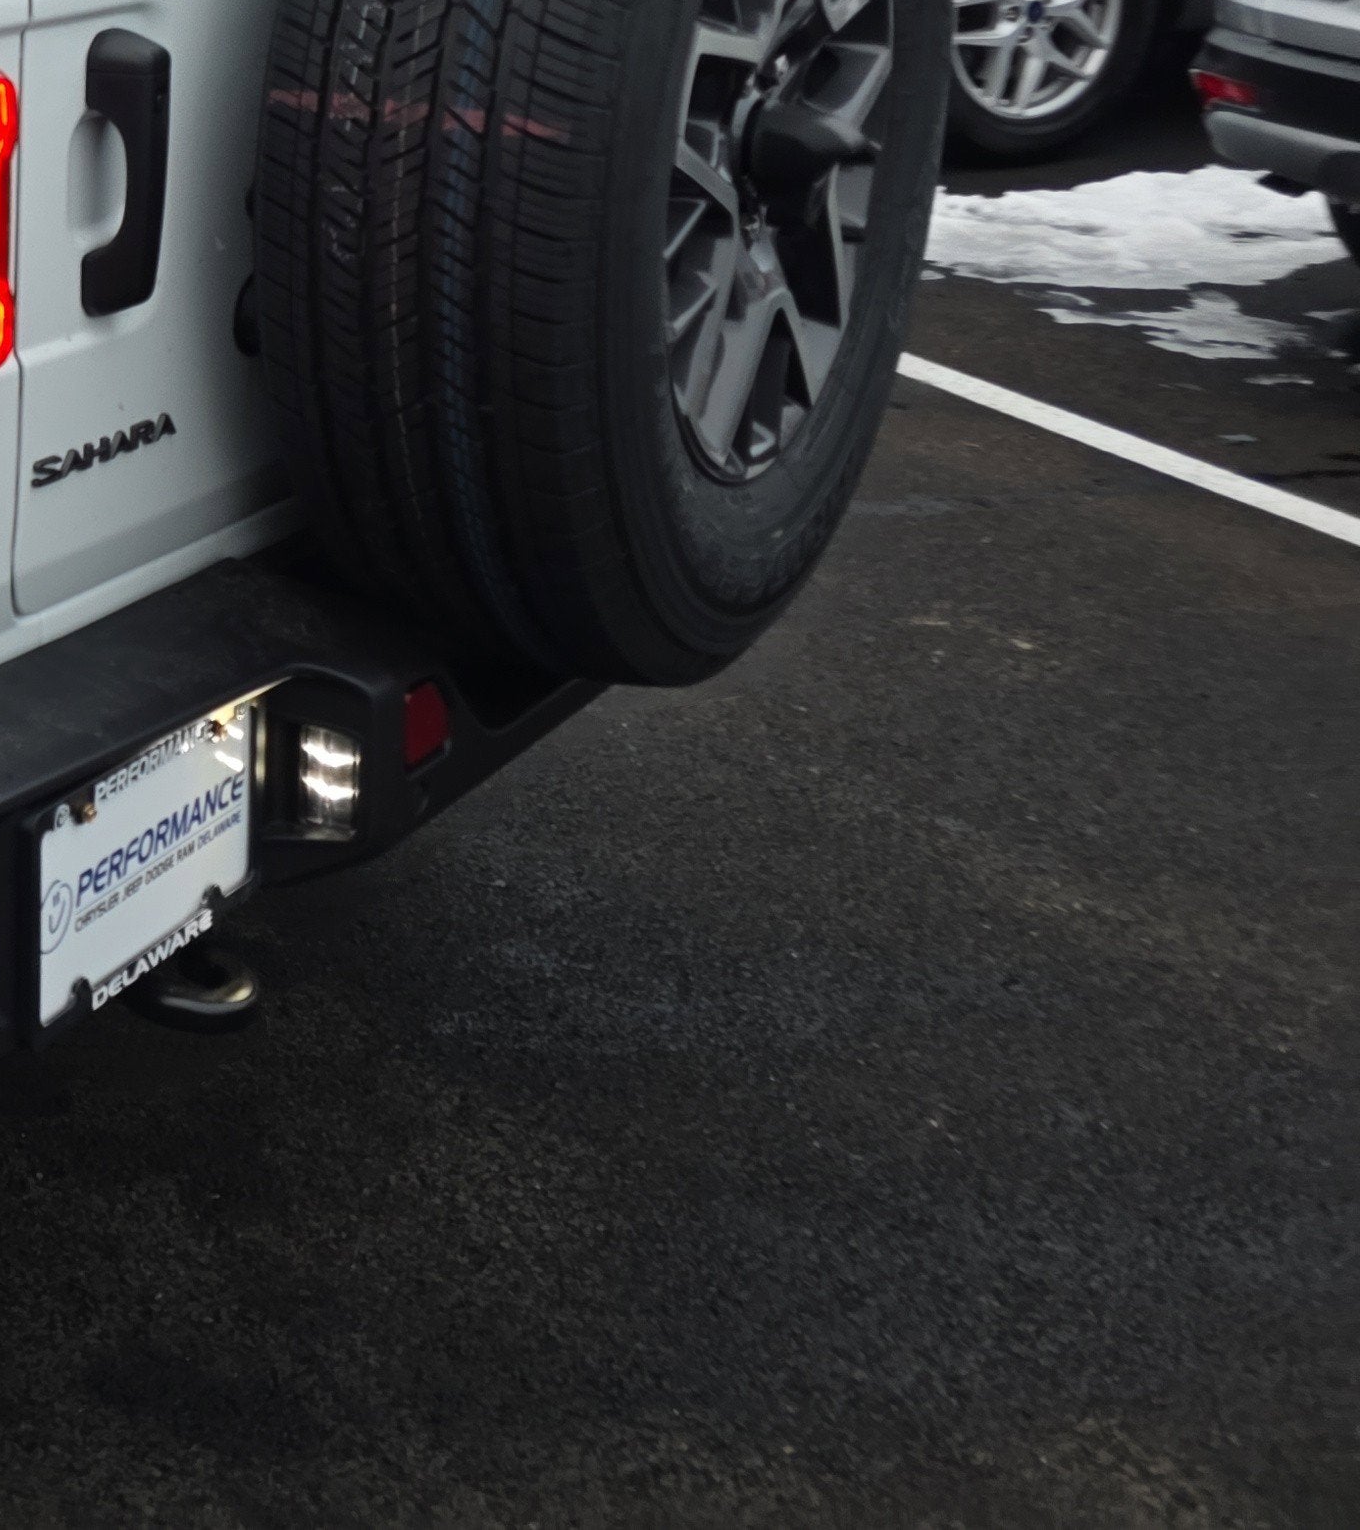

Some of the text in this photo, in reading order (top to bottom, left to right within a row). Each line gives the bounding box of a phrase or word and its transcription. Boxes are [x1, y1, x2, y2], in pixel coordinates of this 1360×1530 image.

[31, 412, 177, 489] SAHARA
[75, 810, 241, 933] CHRYSLER JEEP DODGE RAM DELAWARE
[76, 772, 245, 908] PERFORMANCE
[92, 908, 213, 1011] DELAWARE
